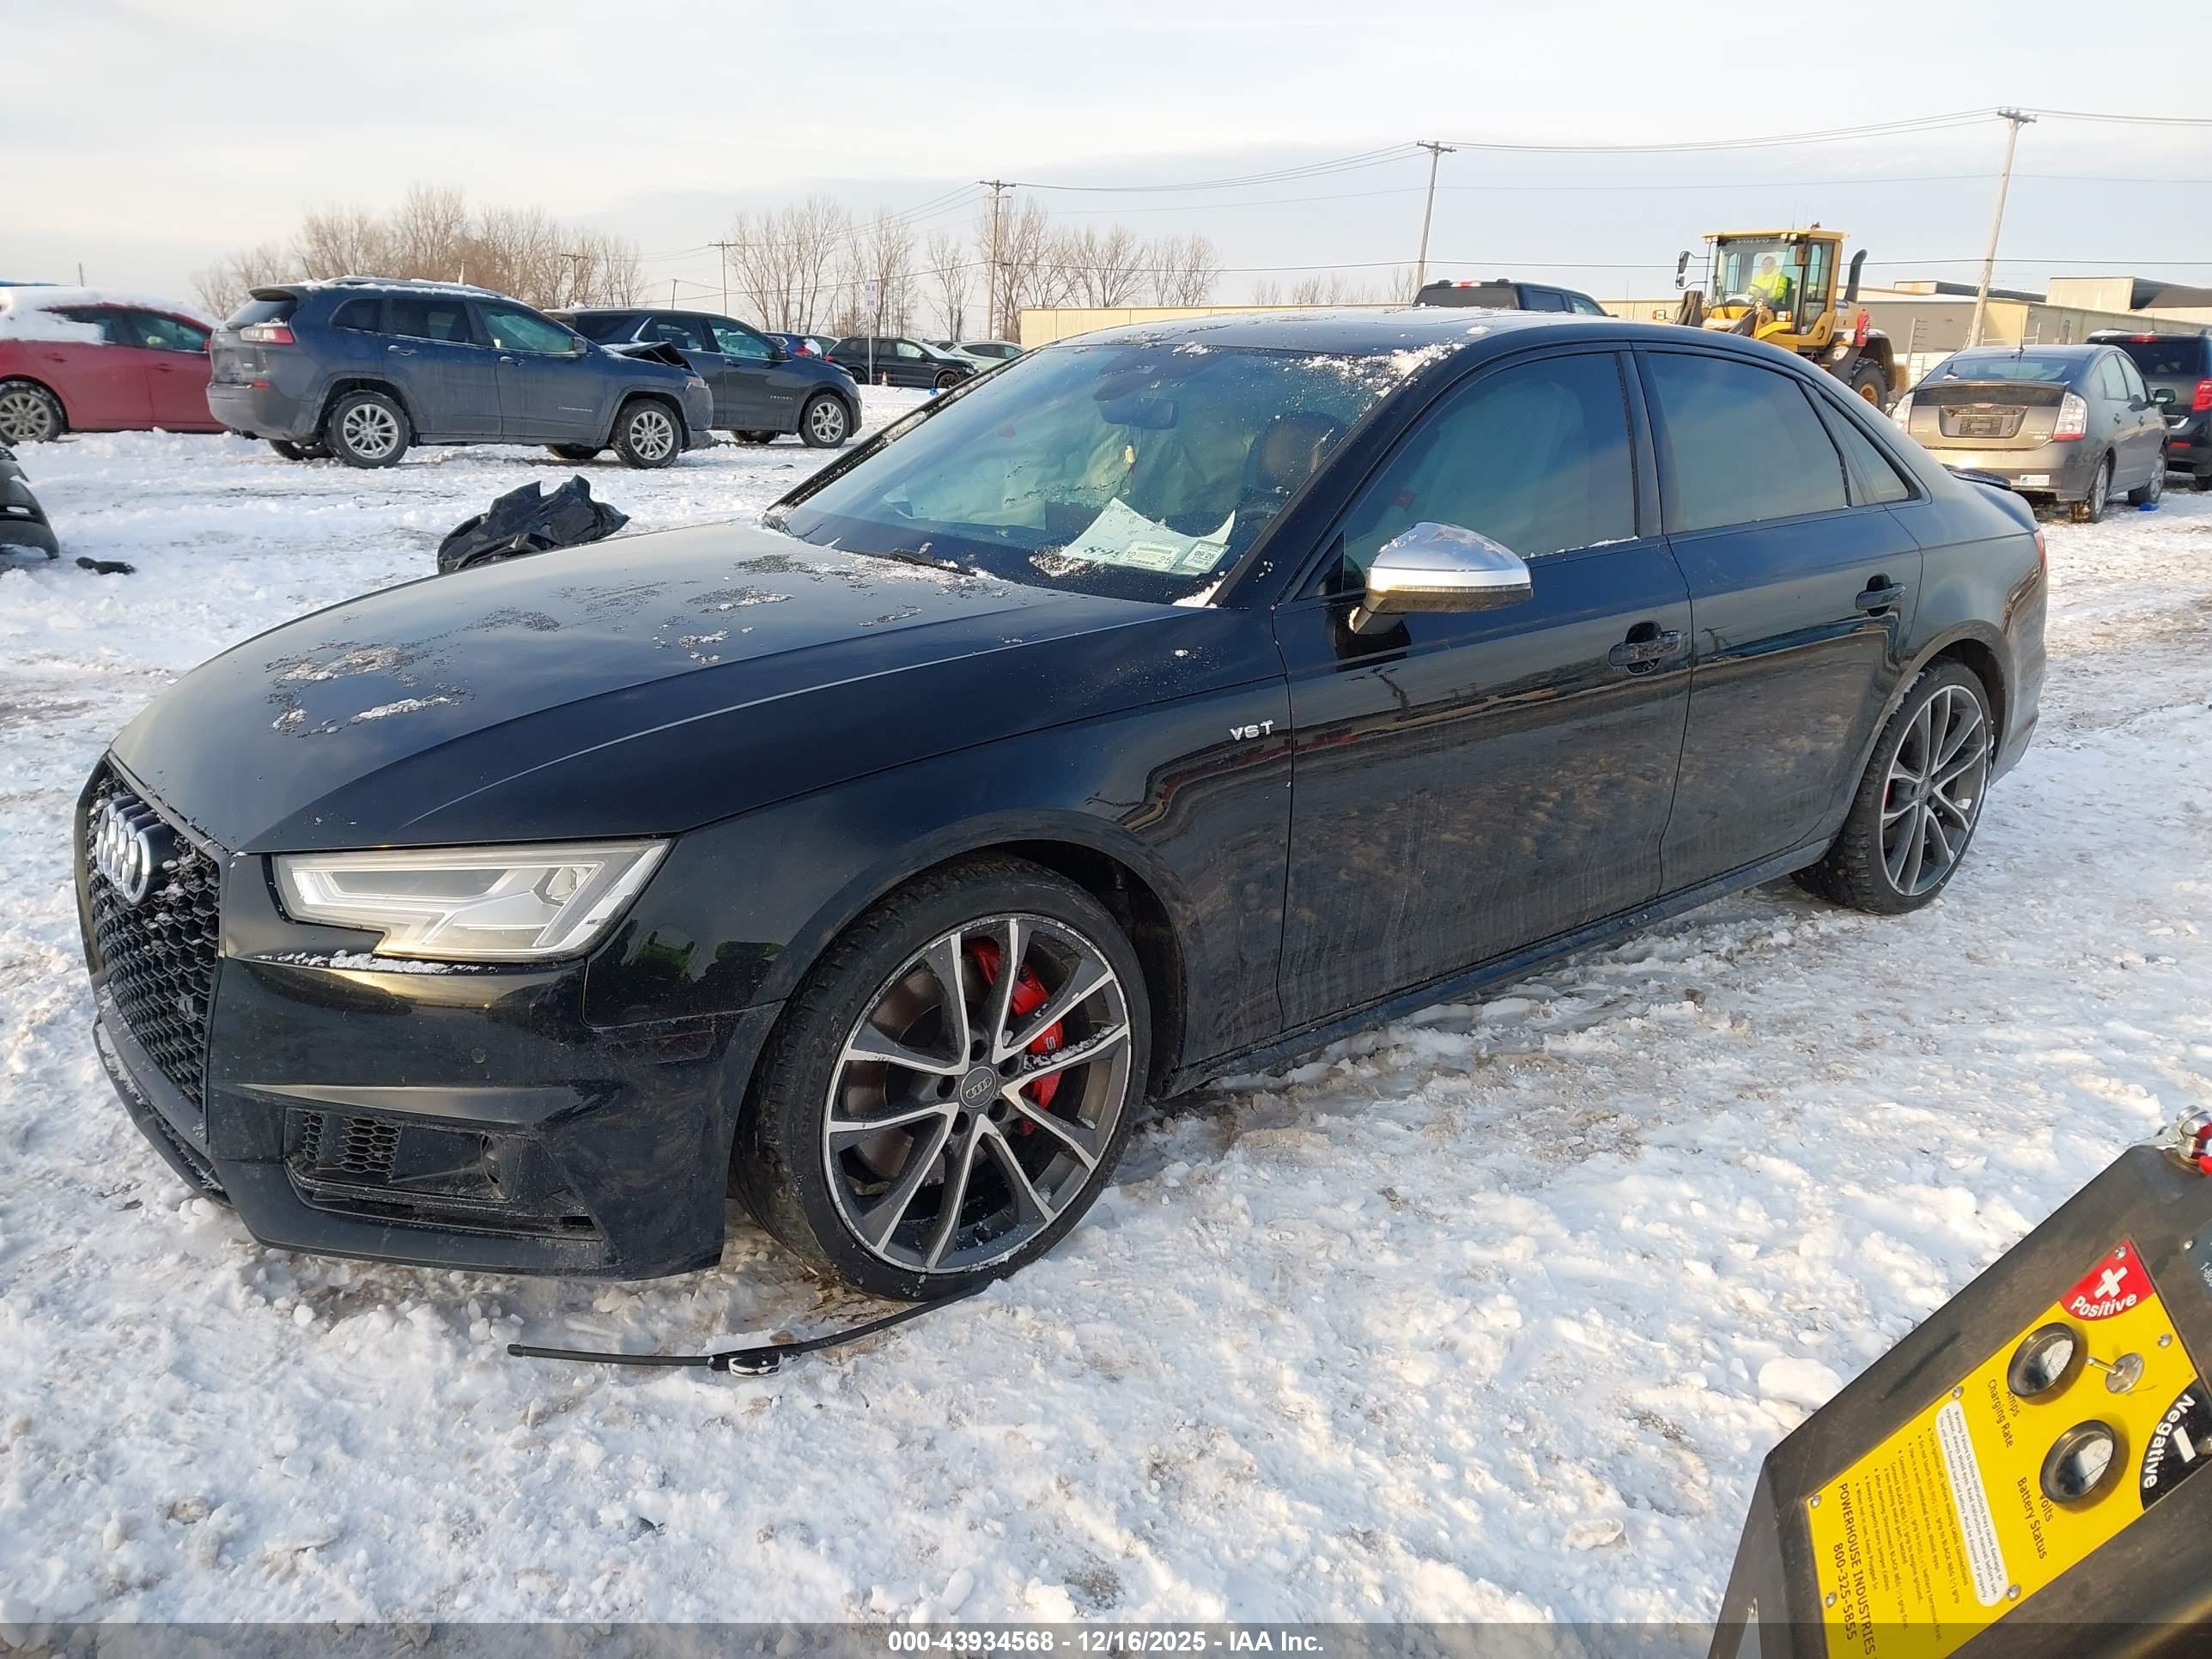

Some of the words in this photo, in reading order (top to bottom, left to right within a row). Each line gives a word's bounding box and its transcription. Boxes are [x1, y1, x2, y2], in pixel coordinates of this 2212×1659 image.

[1229, 719, 1274, 741] V6T
[2070, 1293, 2137, 1318] Positive
[1988, 1378, 2006, 1424] Charging
[2001, 1422, 2014, 1448] Rate
[2143, 1394, 2196, 1489] Negative
[2017, 1476, 2035, 1520] Battery
[2030, 1519, 2047, 1559] Status
[1839, 1484, 1861, 1567] POWERHOUSE
[1853, 1571, 1875, 1655] INDUSTRIES
[1922, 1569, 1932, 1593] battery
[1979, 1536, 1989, 1559] manual
[1985, 1560, 1994, 1580] before
[1990, 1548, 2000, 1572] damage
[1833, 1544, 1857, 1639] 800-325-5855
